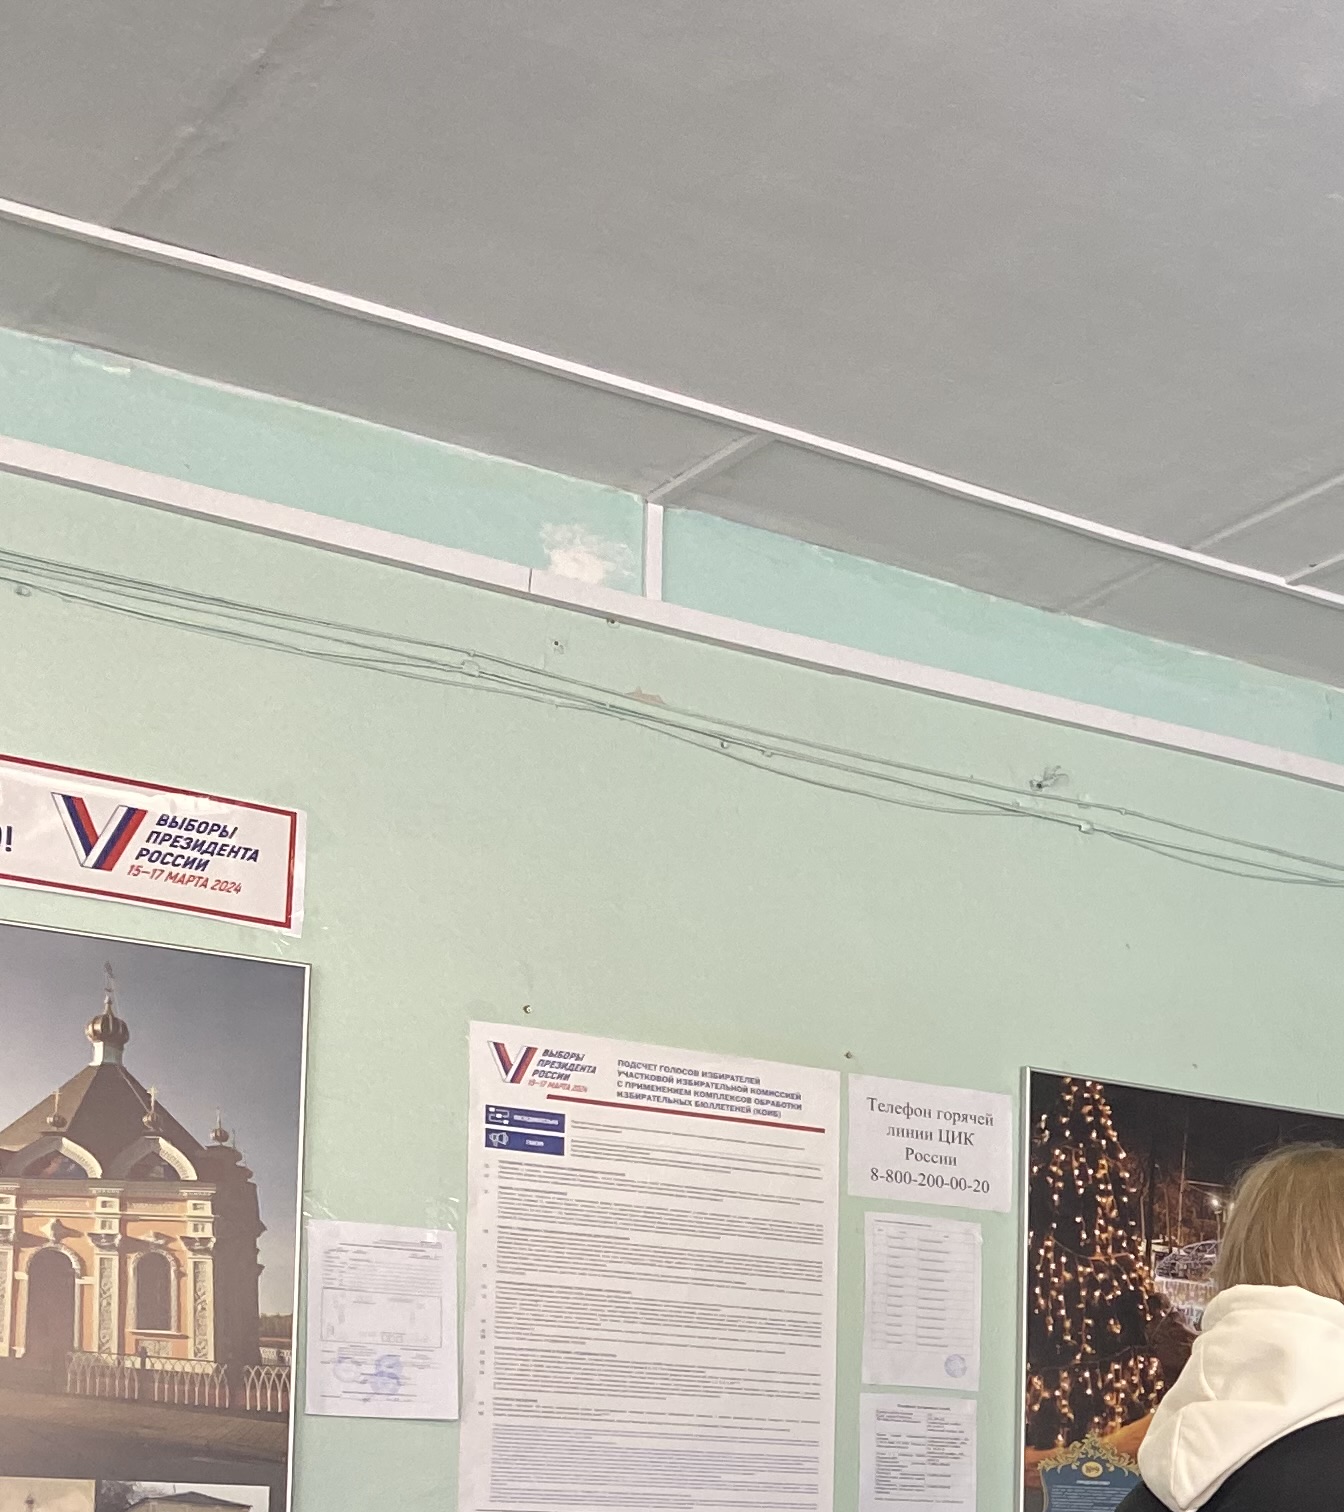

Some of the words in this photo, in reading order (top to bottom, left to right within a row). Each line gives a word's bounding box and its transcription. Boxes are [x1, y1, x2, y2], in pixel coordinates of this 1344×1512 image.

[155, 813, 238, 840] ВЫБОРЫ
[145, 830, 261, 863] ПРЕЗИДЕНТА
[135, 848, 210, 872] РОССИИ
[165, 871, 209, 890] МАРТА
[211, 879, 243, 895] 2024
[536, 1058, 597, 1075] ПРЕЗИДЕНТА
[542, 1049, 585, 1062] ВЫБОРЫ
[532, 1069, 571, 1081] РОССИИ
[617, 1059, 658, 1072] ПОДСЧЕТ
[659, 1064, 700, 1077] ГОЛОСОВ
[701, 1070, 761, 1085] ИЗБИРАТЕЛЕЙ
[616, 1080, 623, 1088] С
[624, 1081, 692, 1096] ПРИМЕНЕНИЕМ
[693, 1089, 752, 1104] КОМПЛЕКСОВ
[753, 1097, 803, 1111] ОБРАБОТКИ
[617, 1070, 674, 1084] УЧАСТКОВОЙ
[676, 1078, 749, 1094] ИЗБИРАТЕЛЬНОЙ
[750, 1087, 802, 1101] КОМИССИЕЙ
[616, 1090, 693, 1107] ИЗБИРАТЕЛЬНЫХ
[694, 1100, 751, 1114] БЮЛЛЕТЕНЕЙ
[753, 1108, 782, 1119] (КОИБ)
[866, 1097, 932, 1120] Телефон
[936, 1109, 994, 1127] горячей
[886, 1126, 933, 1141] линии
[938, 1128, 975, 1146] ЦИК
[905, 1147, 957, 1167] России
[870, 1167, 990, 1194] 8-800-200-00-20
